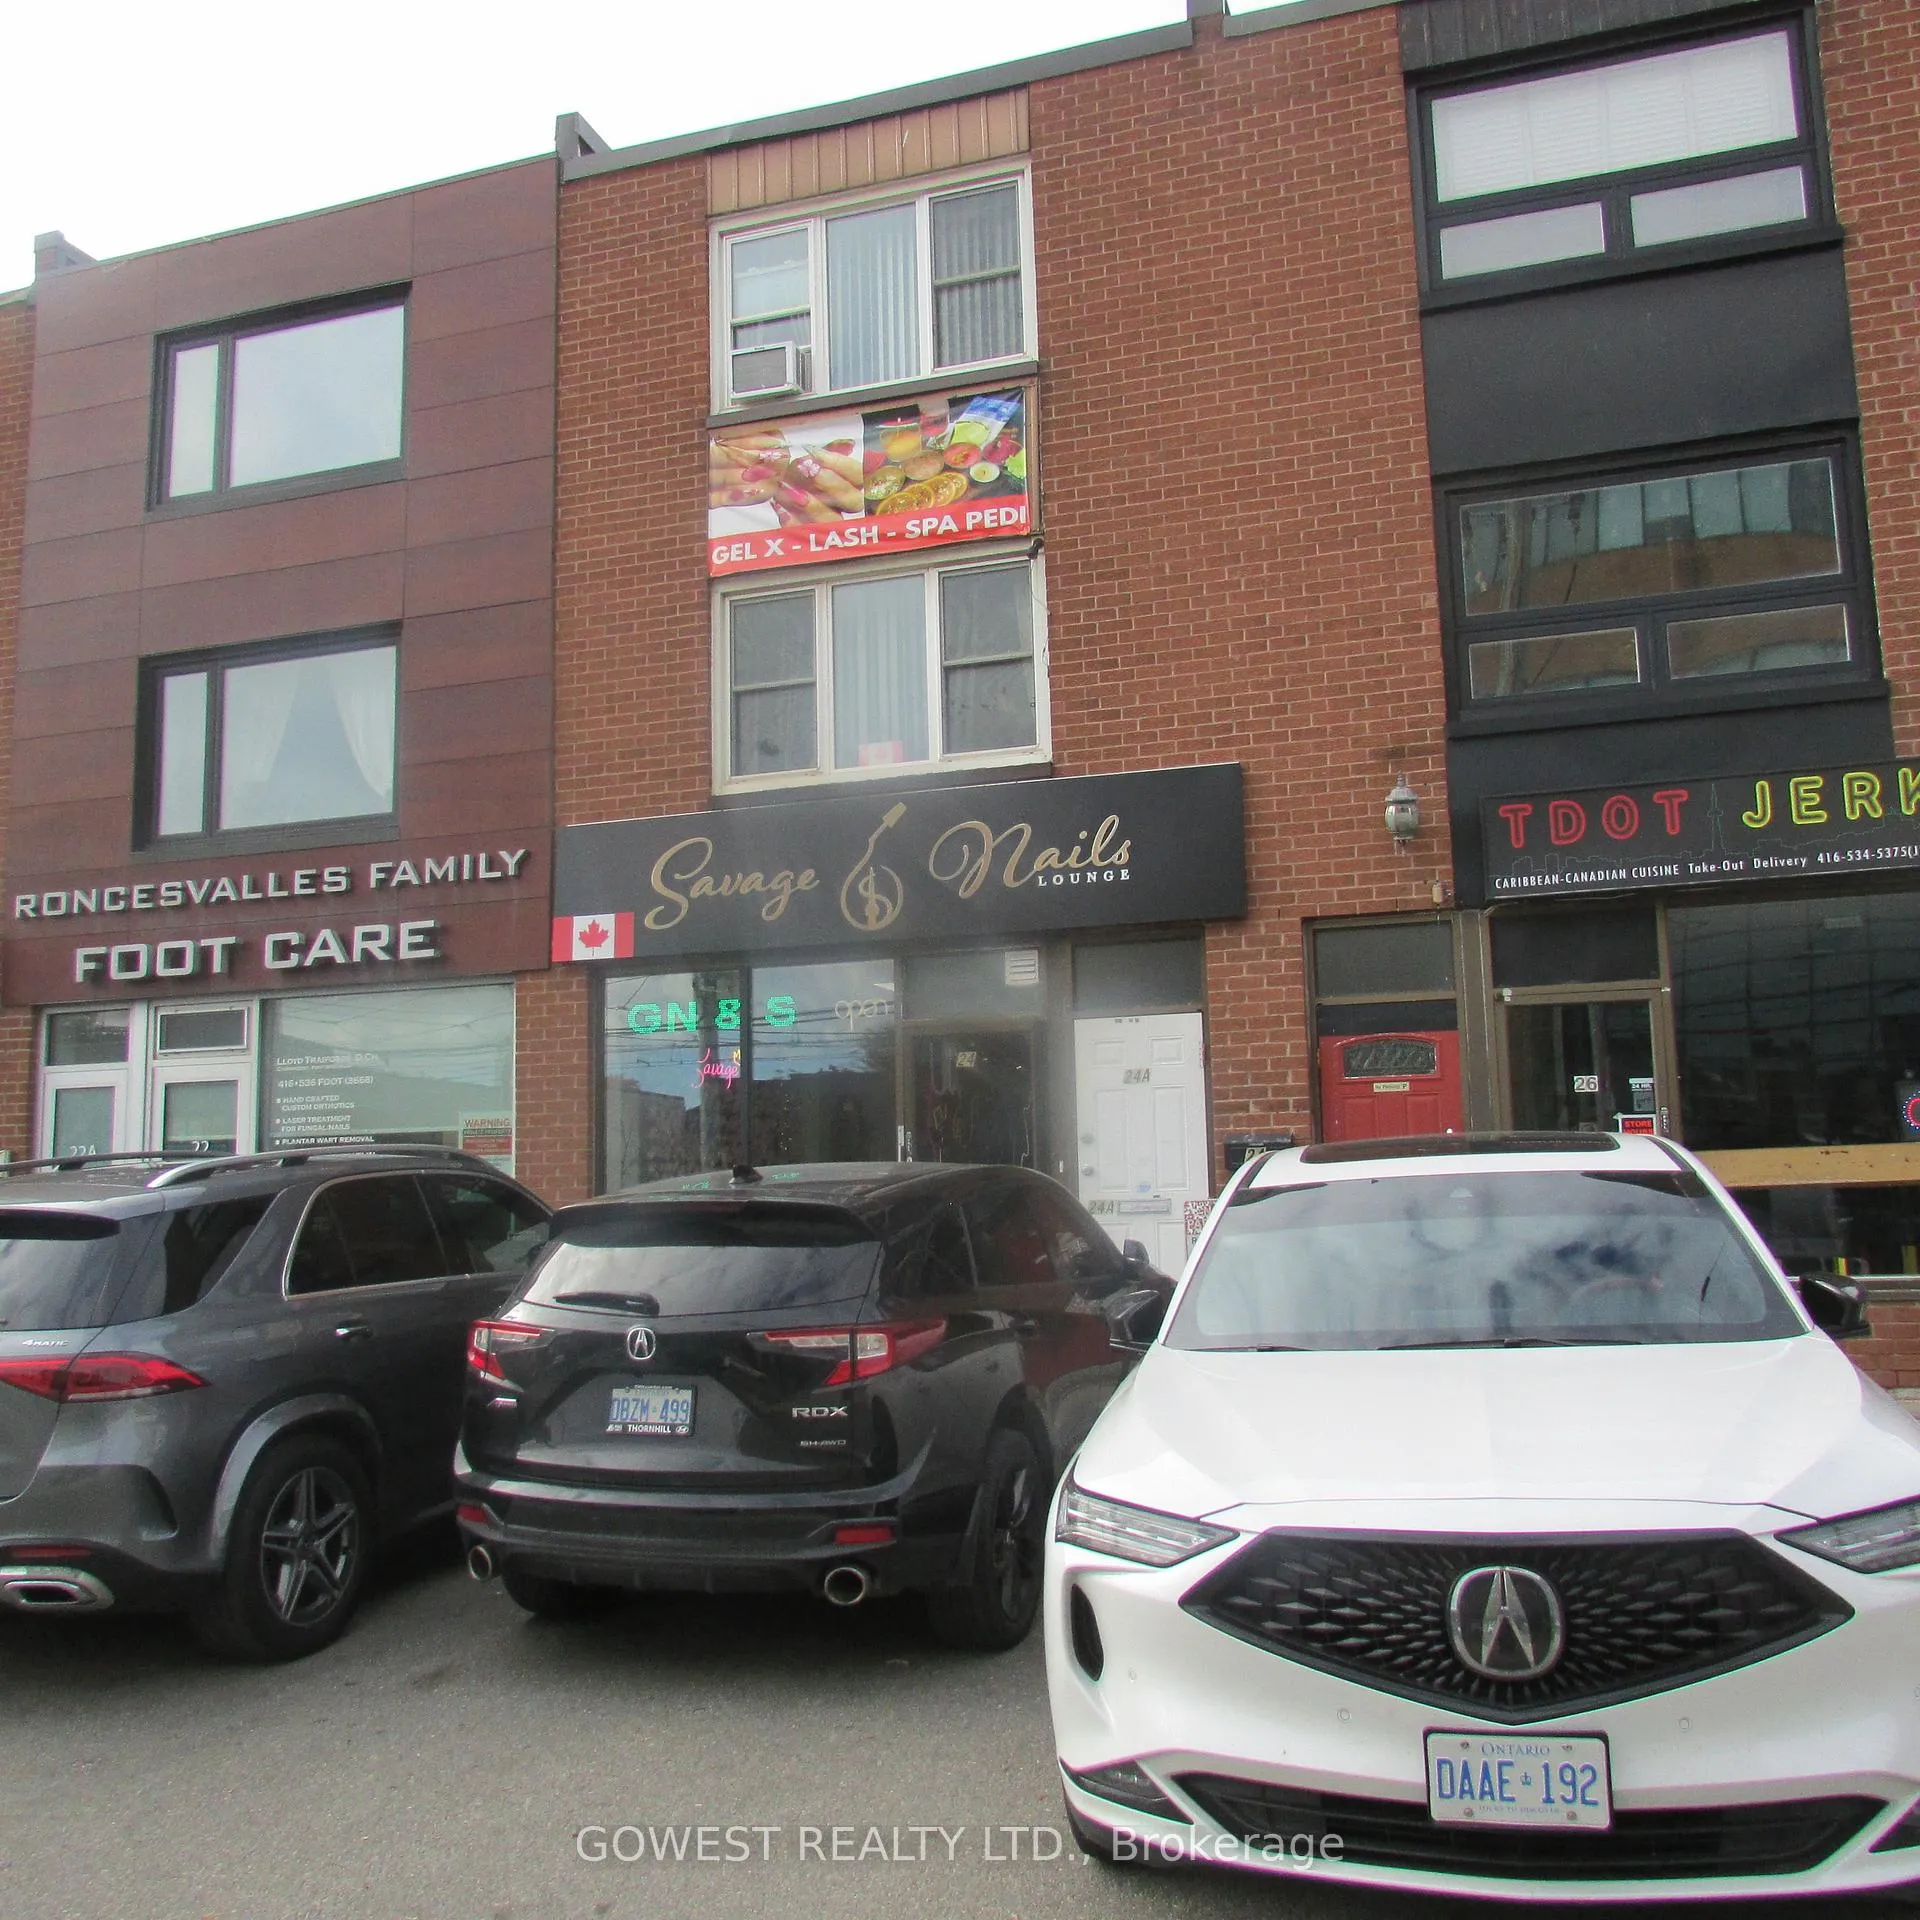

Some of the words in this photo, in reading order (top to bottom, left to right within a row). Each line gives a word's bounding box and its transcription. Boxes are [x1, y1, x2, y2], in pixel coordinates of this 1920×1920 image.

[711, 542, 757, 566] GEL
[764, 537, 785, 558] X
[809, 525, 878, 552] LASH
[905, 513, 959, 539] SPA
[966, 505, 1028, 531] PEDI
[1499, 789, 1689, 849] TDOT
[644, 837, 821, 930] Savage
[929, 814, 1132, 900] Nails
[1038, 869, 1132, 888] LOUNGE
[1495, 868, 1627, 890] CARIBBEAN-CANADIAN
[1632, 863, 1680, 879] CUISINE
[1688, 859, 1745, 875] Take-Out
[1753, 855, 1807, 869] Delivery
[15, 865, 352, 919] RONCESVALLES
[369, 848, 527, 890] FAMILY
[74, 936, 238, 983] FOOT
[264, 919, 438, 970] CARE
[1123, 1067, 1151, 1085] 24A
[1575, 1077, 1597, 1091] 26
[464, 1118, 511, 1128] WARNING
[338, 1135, 375, 1143] REMOVAL
[69, 1144, 96, 1156] 22A
[660, 1398, 690, 1423] 499
[792, 1406, 848, 1418] RDX
[628, 1424, 672, 1433] THORNHILL
[1481, 1742, 1551, 1756] ONTARIO
[1436, 1758, 1516, 1803] DAAE
[1541, 1760, 1600, 1806] 192
